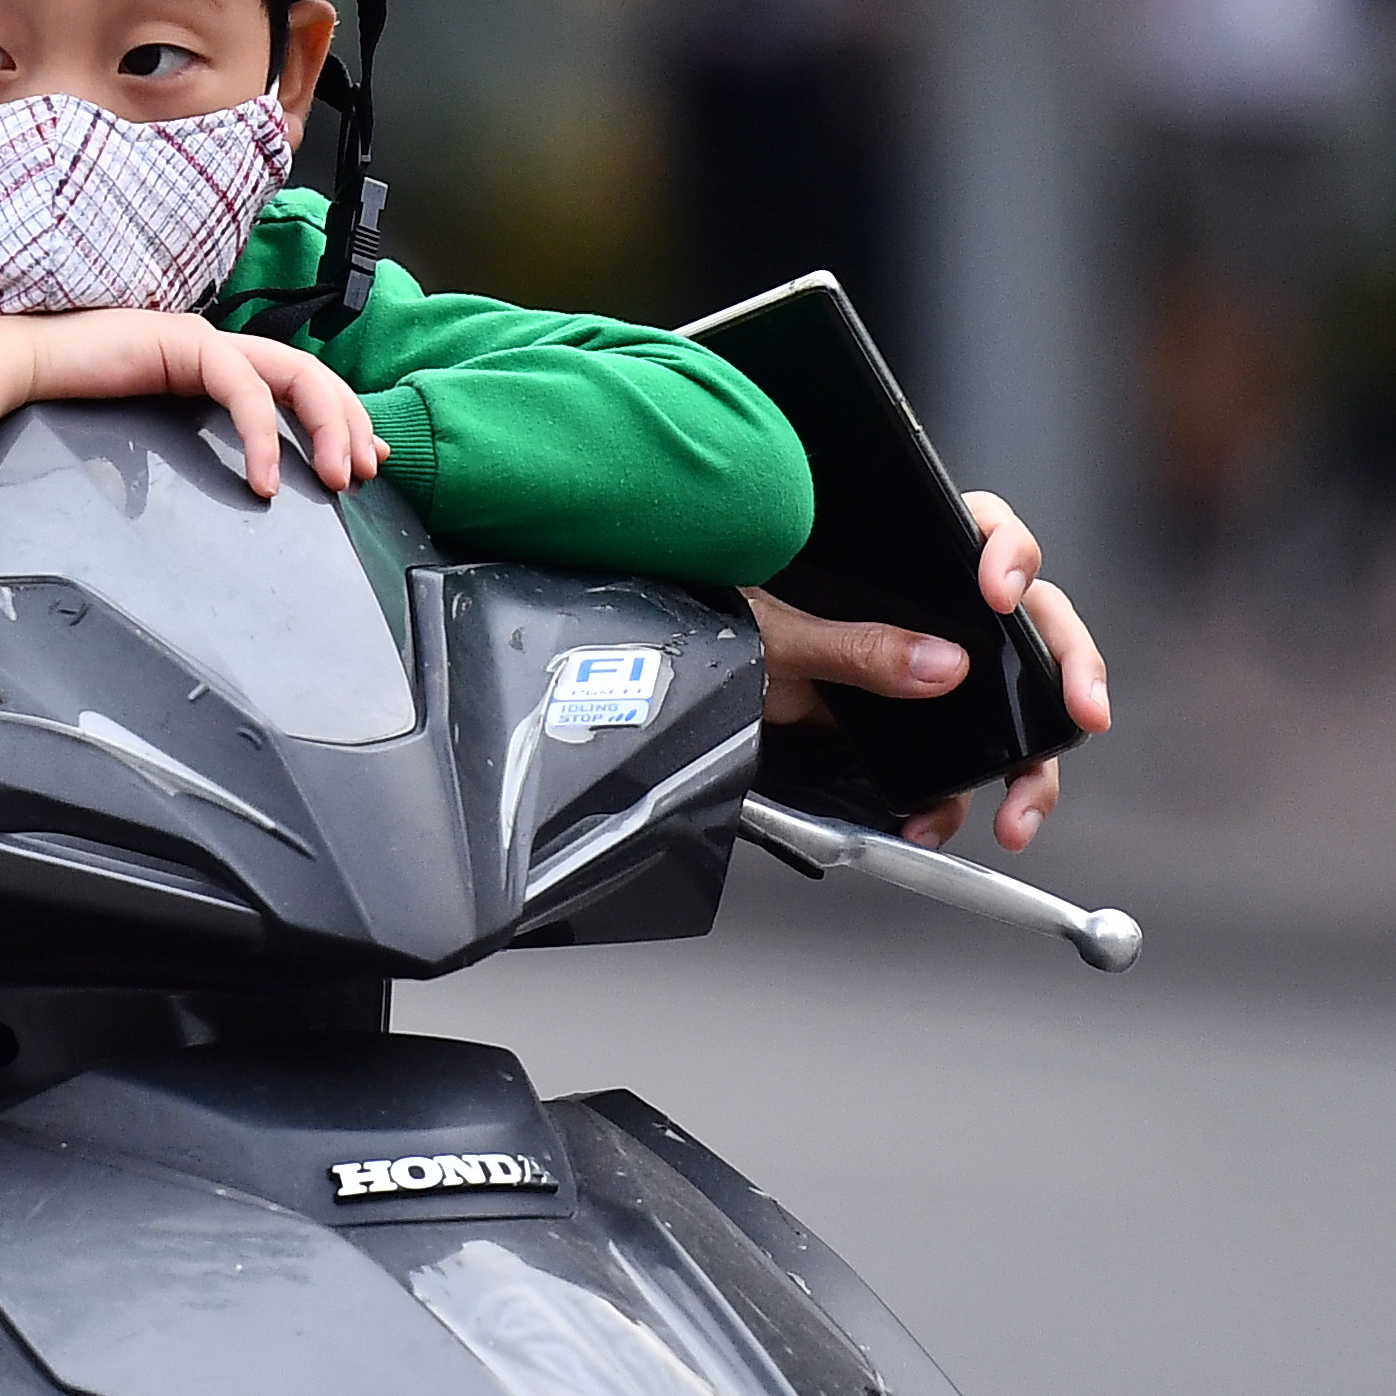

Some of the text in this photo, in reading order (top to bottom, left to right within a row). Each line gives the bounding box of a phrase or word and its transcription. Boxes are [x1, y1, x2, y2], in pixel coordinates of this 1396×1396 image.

[575, 657, 645, 683] FI
[561, 703, 619, 713] IDLING
[558, 713, 604, 723] STOP
